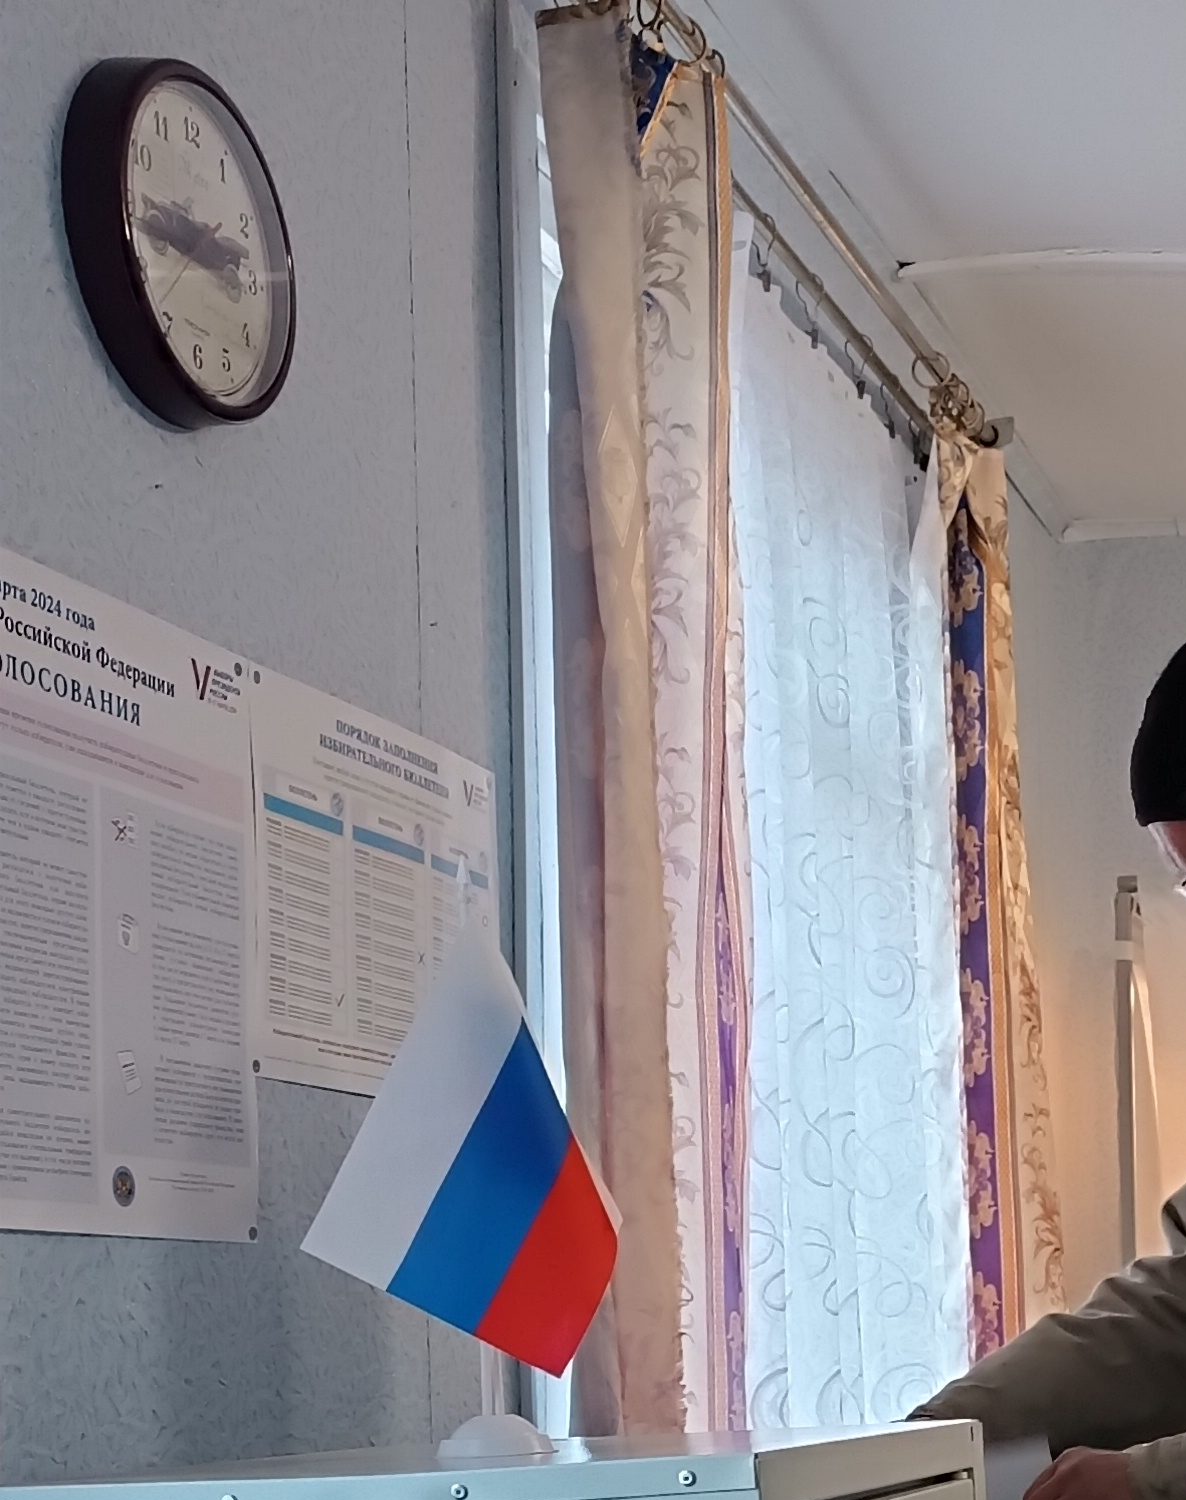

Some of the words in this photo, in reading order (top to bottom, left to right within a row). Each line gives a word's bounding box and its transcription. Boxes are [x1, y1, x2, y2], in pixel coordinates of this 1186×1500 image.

[154, 111, 169, 143] 11
[184, 116, 200, 149] 12
[219, 158, 226, 184] 1
[240, 212, 249, 239] 2
[248, 270, 258, 296] 3
[242, 323, 250, 348] 4
[193, 344, 203, 369] 6
[222, 348, 231, 373] 5
[0, 580, 26, 603] рта
[31, 588, 62, 617] 2024
[65, 607, 95, 631] года
[96, 646, 175, 697] Федерации
[0, 653, 141, 726] ЛОСОВАНИЯ
